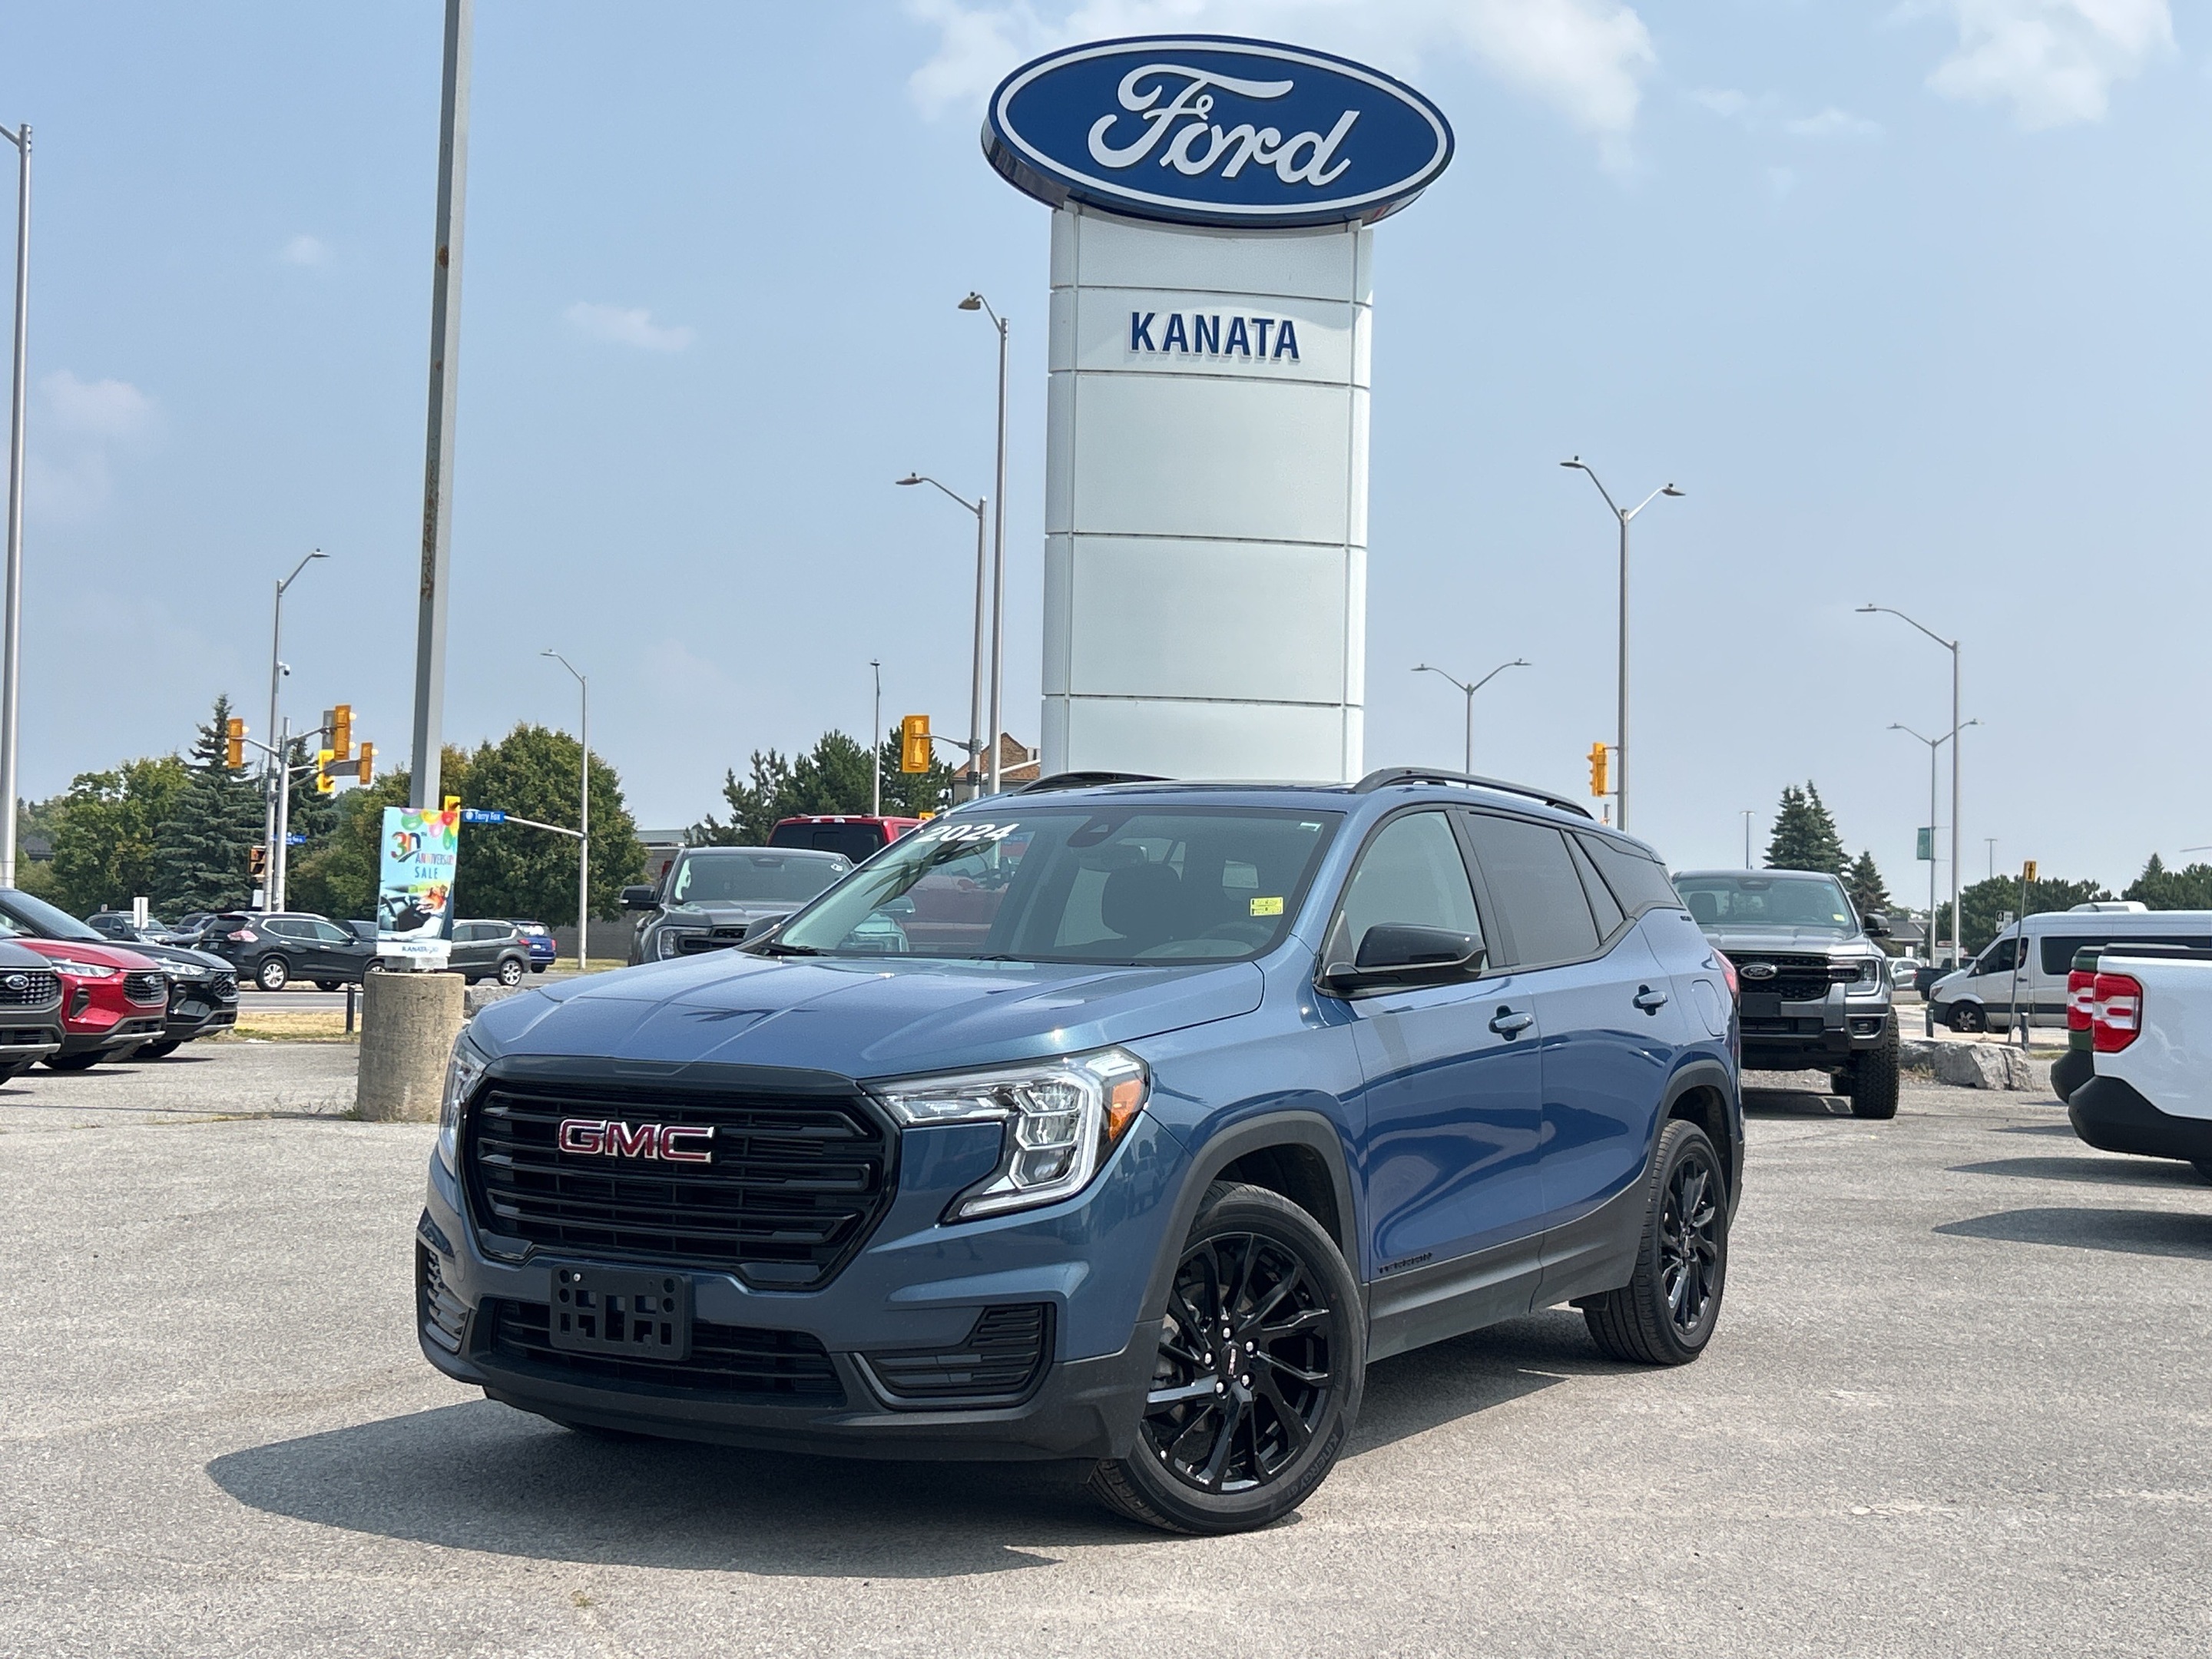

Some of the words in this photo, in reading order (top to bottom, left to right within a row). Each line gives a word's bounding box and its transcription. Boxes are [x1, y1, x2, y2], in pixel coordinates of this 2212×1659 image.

[1087, 63, 1360, 186] Ford
[1131, 311, 1300, 361] KANATA
[913, 823, 1020, 843] 2024
[414, 866, 439, 880] SALE
[559, 1118, 714, 1164] GMC
[1300, 1432, 1339, 1491] KINERGY
